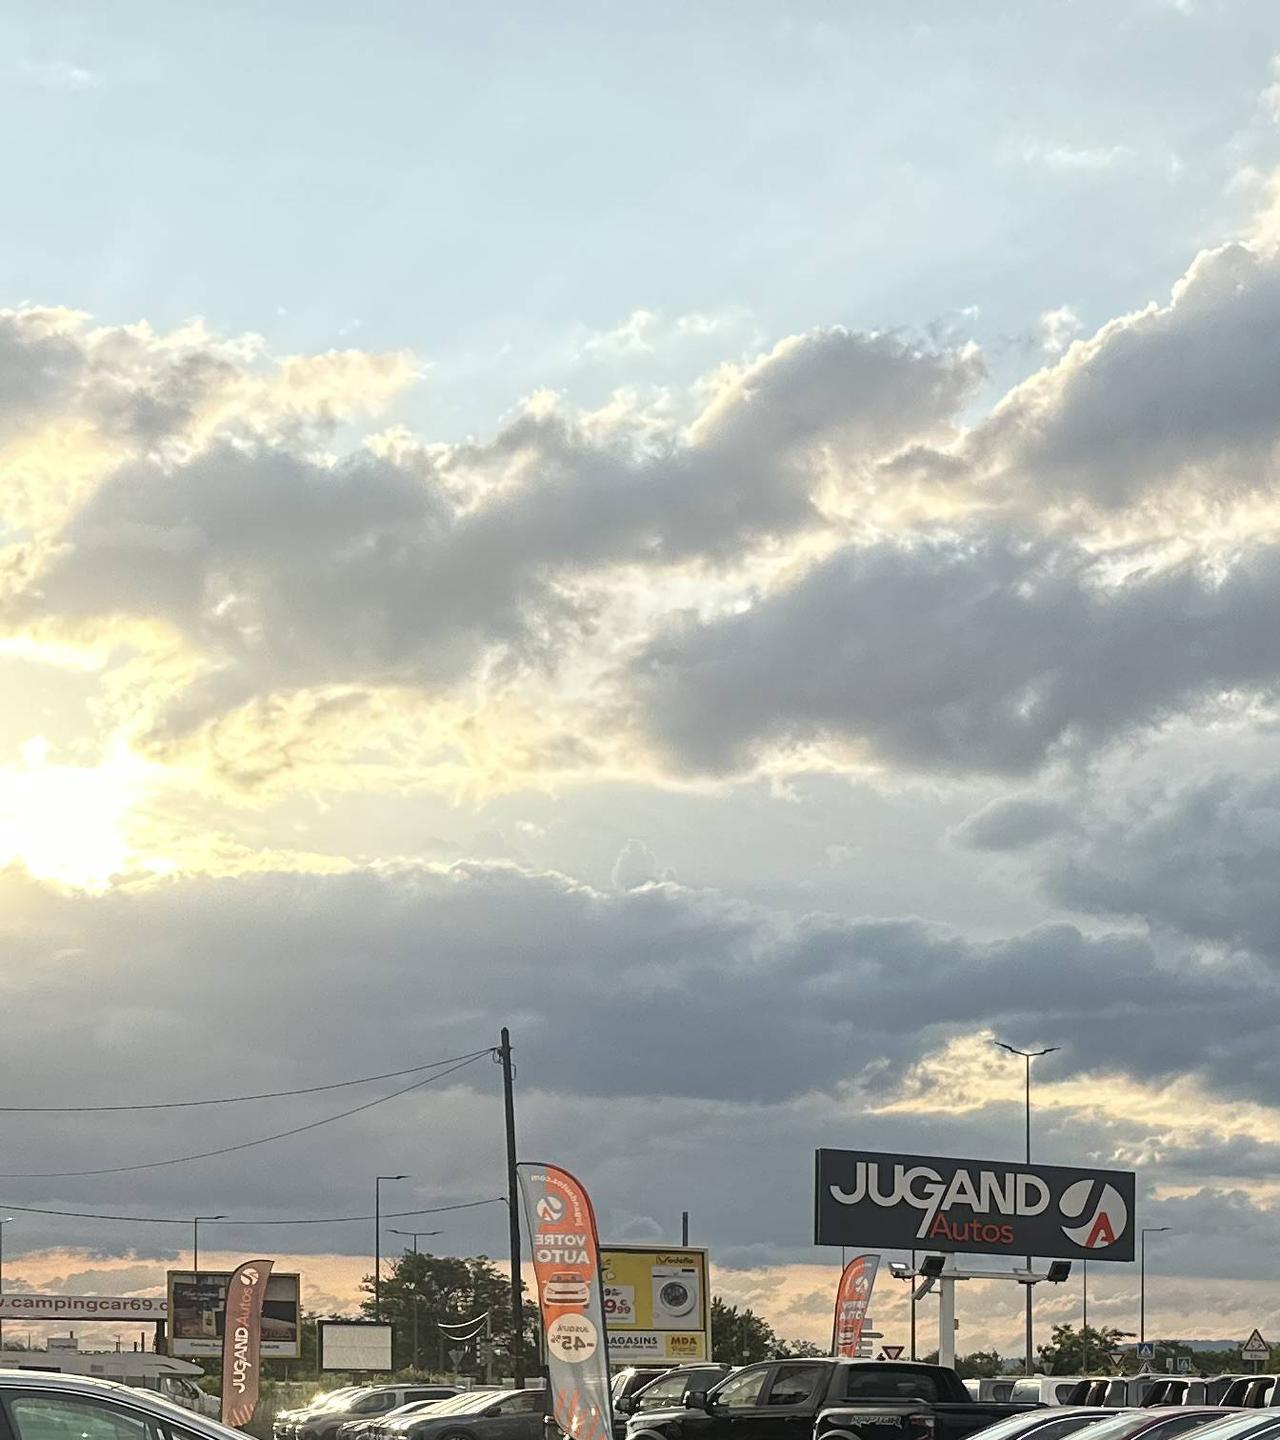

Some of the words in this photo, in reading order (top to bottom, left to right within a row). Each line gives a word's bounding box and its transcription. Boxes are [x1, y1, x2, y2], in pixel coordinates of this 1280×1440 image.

[830, 1162, 1050, 1238] JUGAND
[930, 1213, 1013, 1244] Autos
[606, 1336, 658, 1345] AGASINS
[671, 1337, 697, 1345] MDA
[232, 1327, 251, 1394] JUGAND
